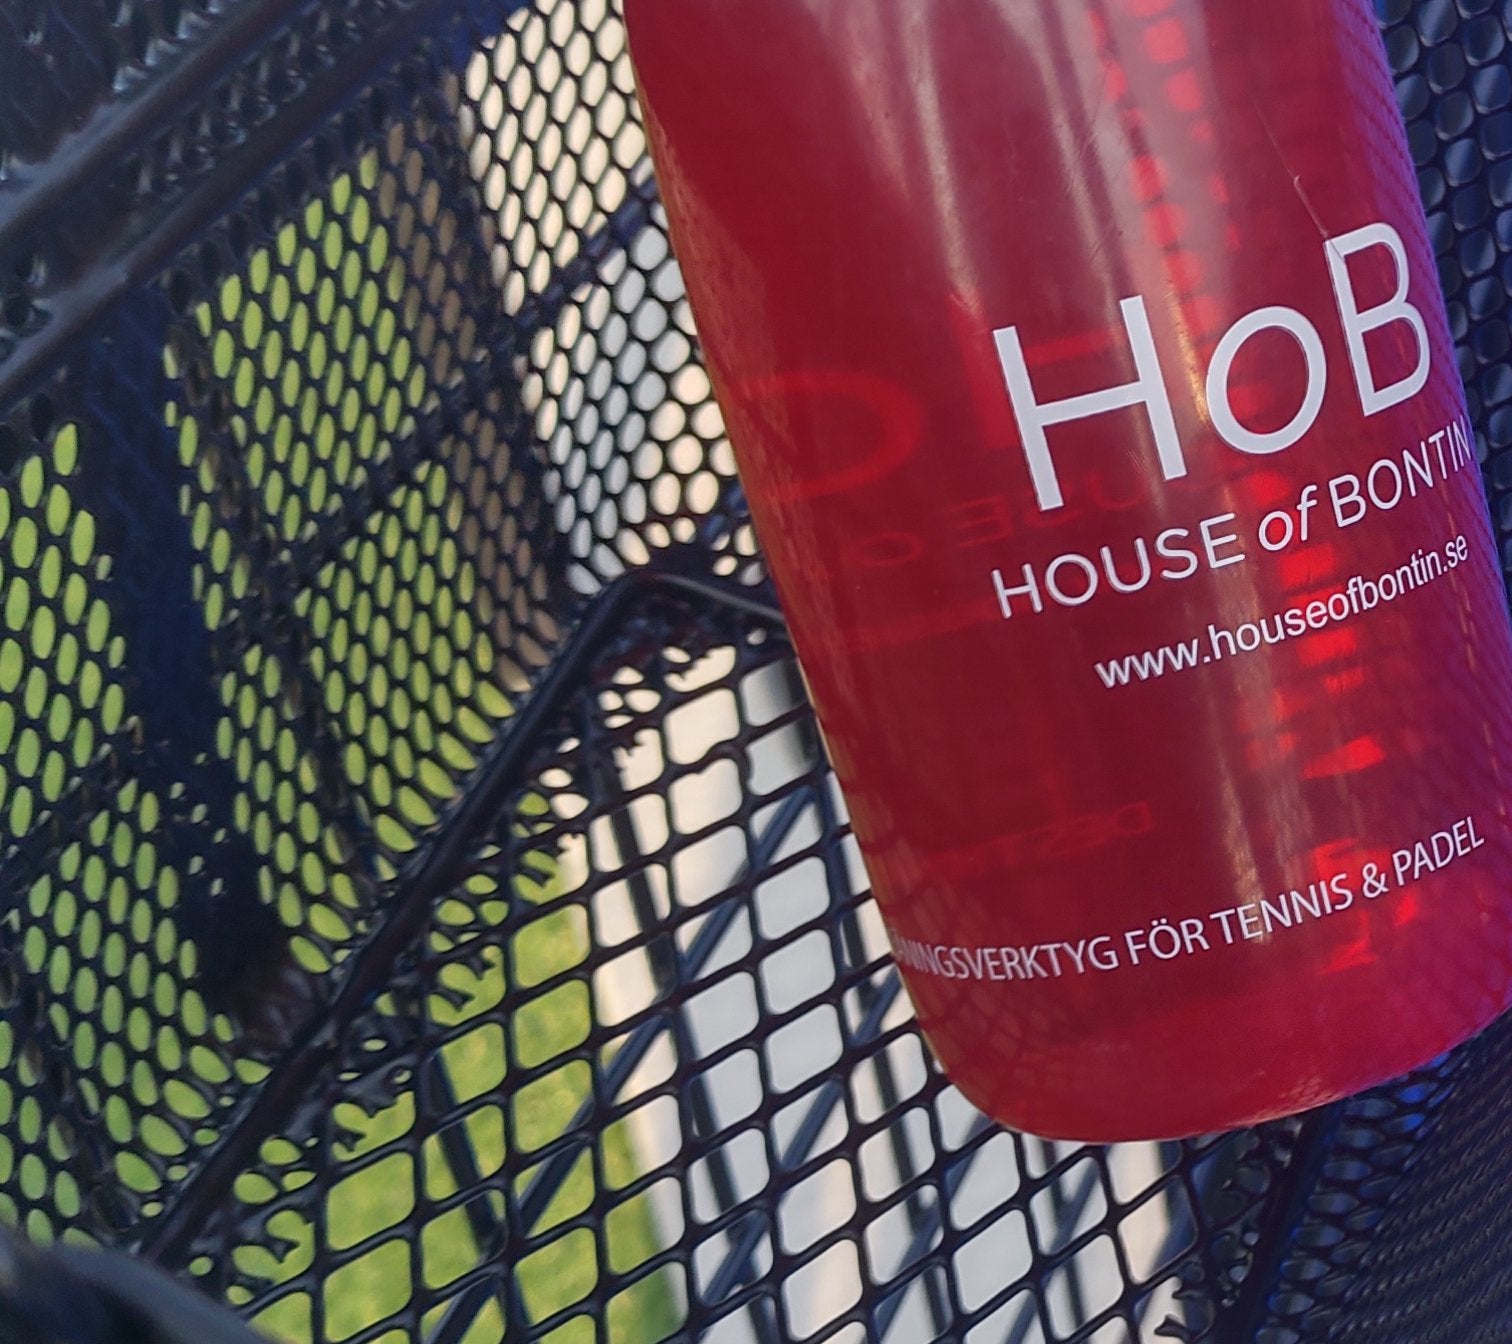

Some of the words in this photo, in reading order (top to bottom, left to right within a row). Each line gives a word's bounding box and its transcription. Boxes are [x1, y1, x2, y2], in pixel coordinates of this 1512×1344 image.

[993, 222, 1431, 512] HoB
[991, 512, 1246, 619] HOUSE
[1257, 484, 1318, 552] of
[1328, 413, 1472, 528] BONTIN
[1094, 534, 1469, 689] www.houseofbontin.se
[1124, 917, 1210, 965] FÖR
[1210, 872, 1353, 946] TENNIS
[1361, 862, 1390, 900] &
[1392, 815, 1485, 887] PADEL
